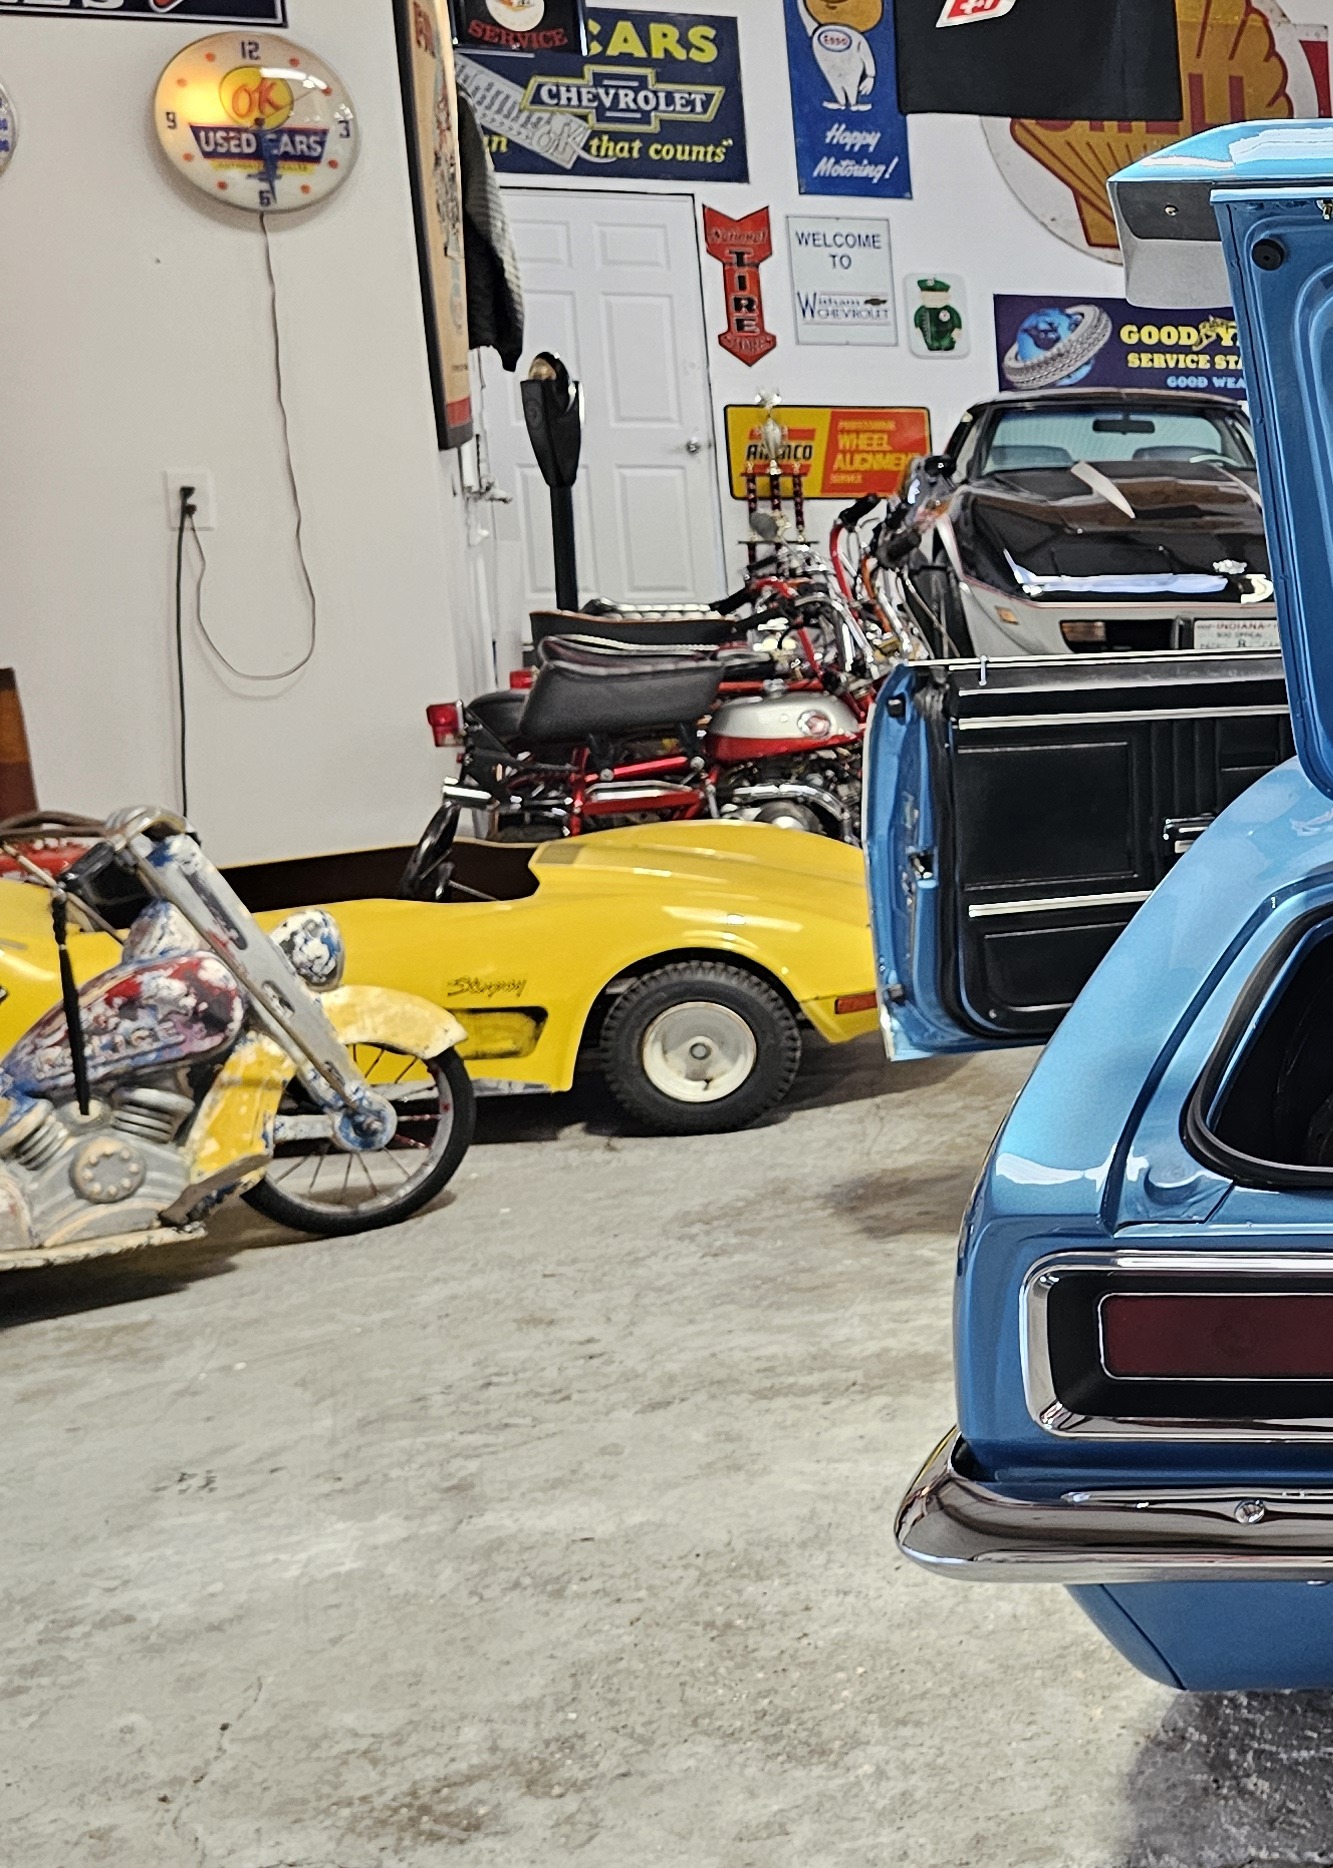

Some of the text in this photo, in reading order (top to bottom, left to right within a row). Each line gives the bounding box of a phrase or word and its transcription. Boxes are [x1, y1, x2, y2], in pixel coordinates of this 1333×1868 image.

[468, 19, 568, 48] SERVICE
[240, 41, 260, 60] 12
[231, 78, 285, 118] OK
[540, 83, 706, 114] CHEVROLET
[165, 111, 177, 129] 9
[338, 119, 351, 139] 3
[199, 131, 257, 154] USED
[588, 134, 642, 160] that
[825, 122, 881, 153] Happy
[812, 155, 899, 184] Motoring!
[795, 230, 882, 249] WELCOME
[828, 253, 852, 270] TO
[726, 248, 760, 335] TIRE
[1126, 352, 1210, 370] SERVICE
[1166, 376, 1209, 389] GOOD
[837, 431, 893, 451] WHEEL
